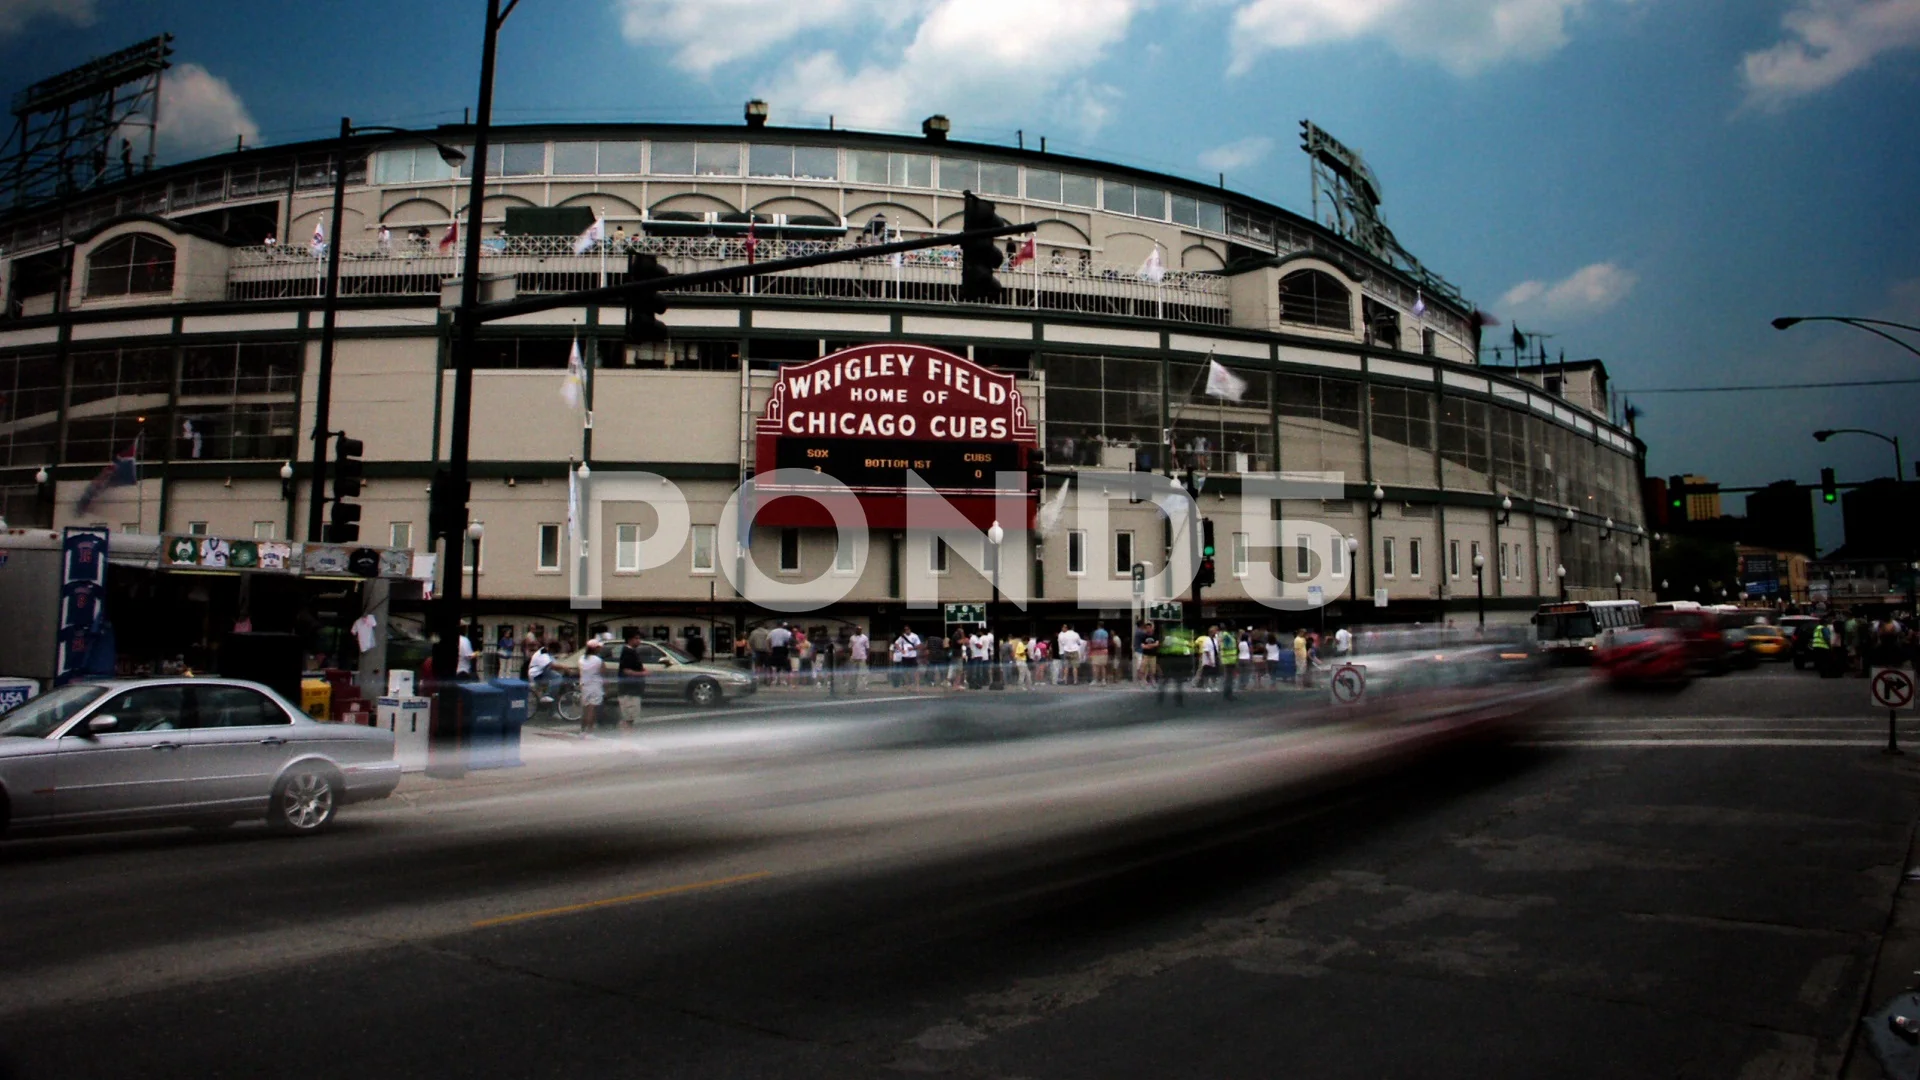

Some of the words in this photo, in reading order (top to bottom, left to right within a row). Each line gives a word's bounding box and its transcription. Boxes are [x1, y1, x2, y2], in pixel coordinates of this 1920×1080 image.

[788, 354, 915, 399] WRIGLEY
[928, 357, 1006, 405] FIELD
[850, 387, 908, 403] HOME
[922, 390, 948, 405] OF
[787, 411, 916, 436] CHICAGO
[930, 415, 1007, 439] CUBS
[806, 449, 829, 458] SOX
[963, 453, 992, 462] CUBS
[864, 459, 909, 469] BOTTOM
[0, 691, 24, 704] USA
